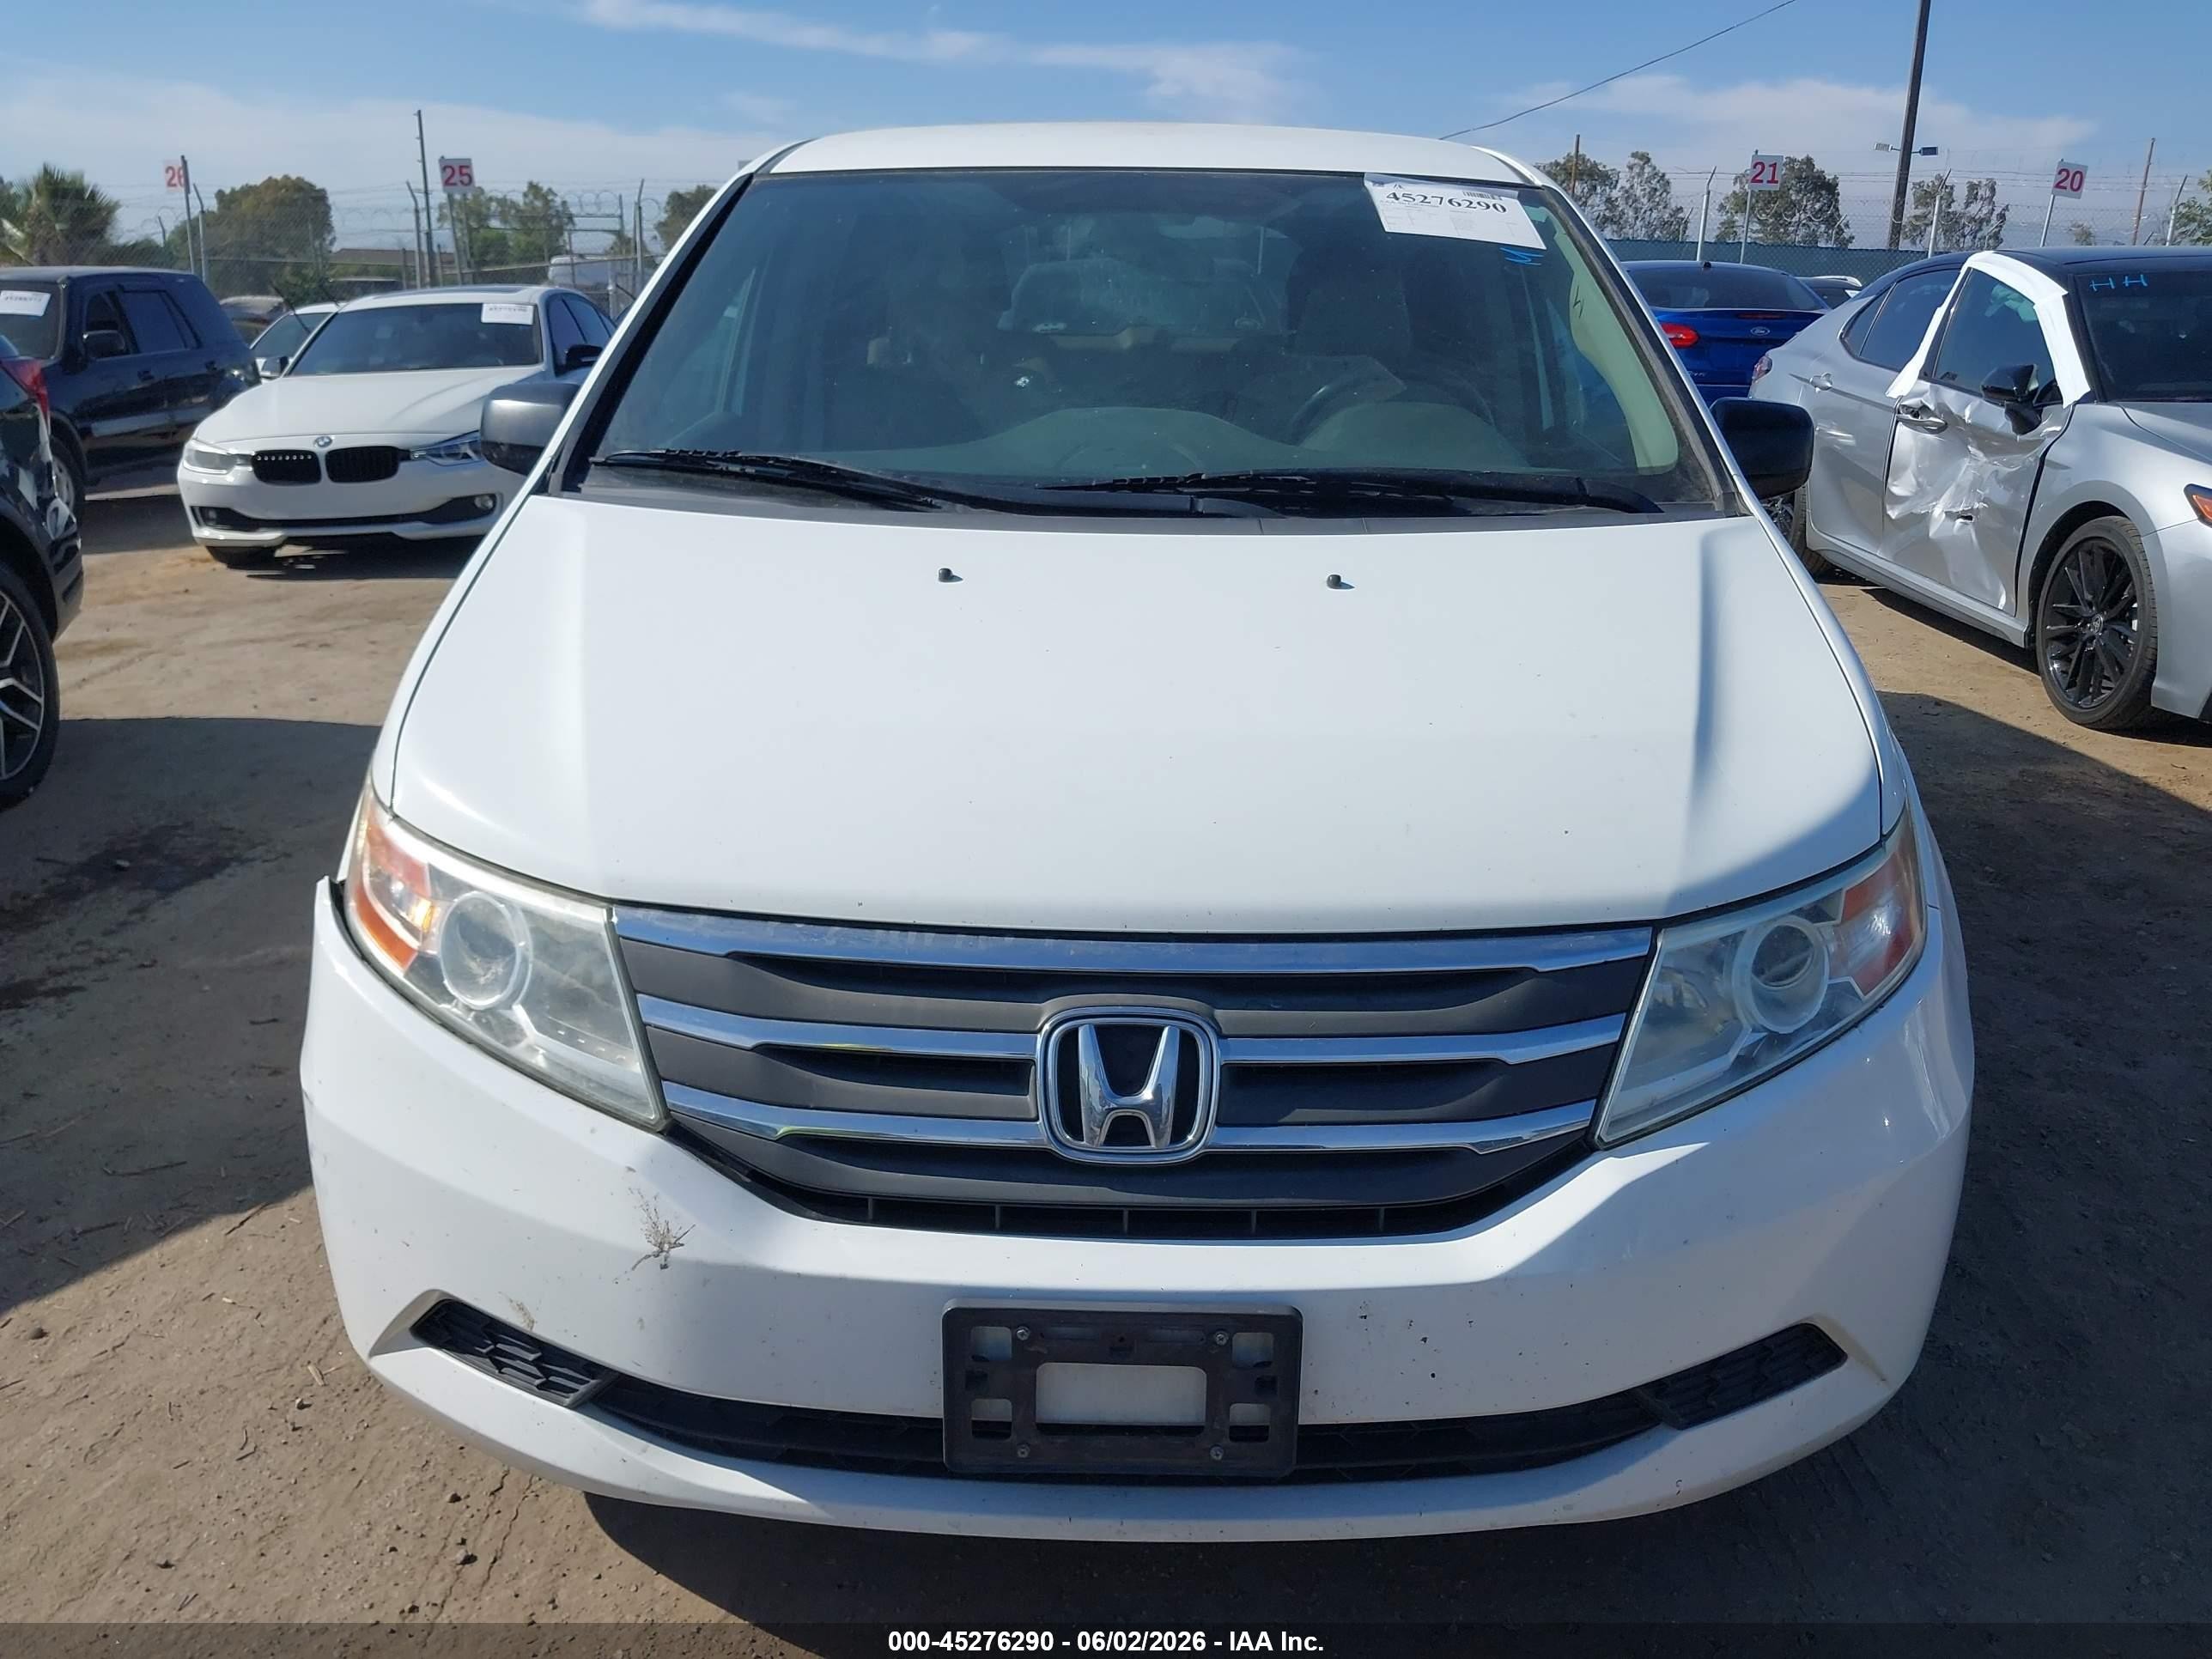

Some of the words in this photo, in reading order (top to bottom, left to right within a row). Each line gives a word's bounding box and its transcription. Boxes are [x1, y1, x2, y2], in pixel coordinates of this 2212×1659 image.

[441, 165, 472, 186] 25
[1751, 161, 1778, 184] 21
[2054, 168, 2083, 191] 20
[1386, 191, 1508, 214] 45276290
